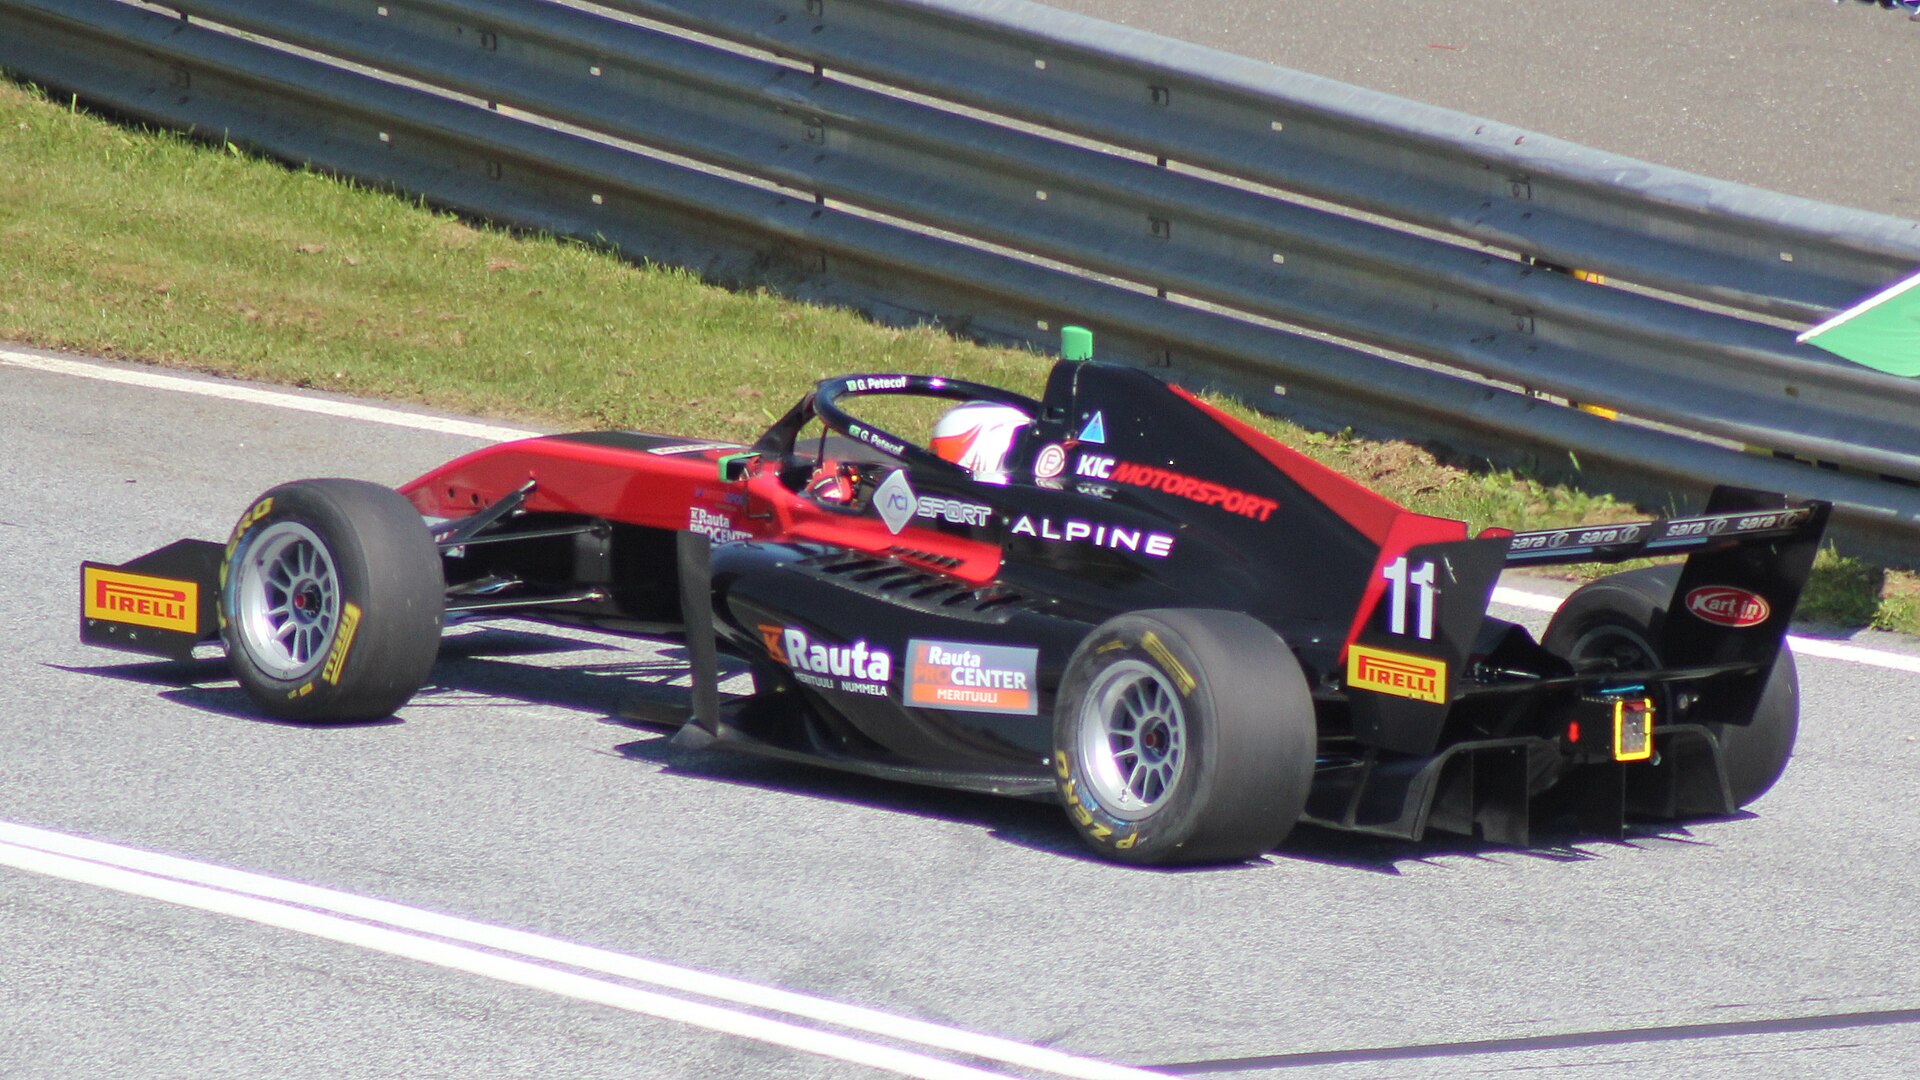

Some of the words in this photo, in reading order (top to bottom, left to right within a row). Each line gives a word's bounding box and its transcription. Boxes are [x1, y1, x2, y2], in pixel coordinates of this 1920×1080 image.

[868, 376, 906, 389] Petecof
[1076, 455, 1115, 479] KIC
[1110, 461, 1280, 522] MOTORSPORT
[699, 509, 729, 528] Rauta
[917, 496, 991, 526] SPORT
[1011, 515, 1174, 557] ALPINE
[1510, 536, 1546, 549] sara
[1578, 529, 1617, 543] sara
[1666, 522, 1705, 536] sara
[1737, 515, 1776, 530] sara
[97, 579, 186, 620] PIRELLI
[1383, 557, 1435, 639] 11
[1692, 594, 1736, 612] Kart
[1741, 600, 1758, 614] in
[784, 628, 890, 681] Rauta
[928, 646, 981, 667] Rauta
[841, 681, 888, 697] NUMMELA
[1358, 655, 1436, 693] PIRELLI
[937, 689, 998, 703] MERITUULI
